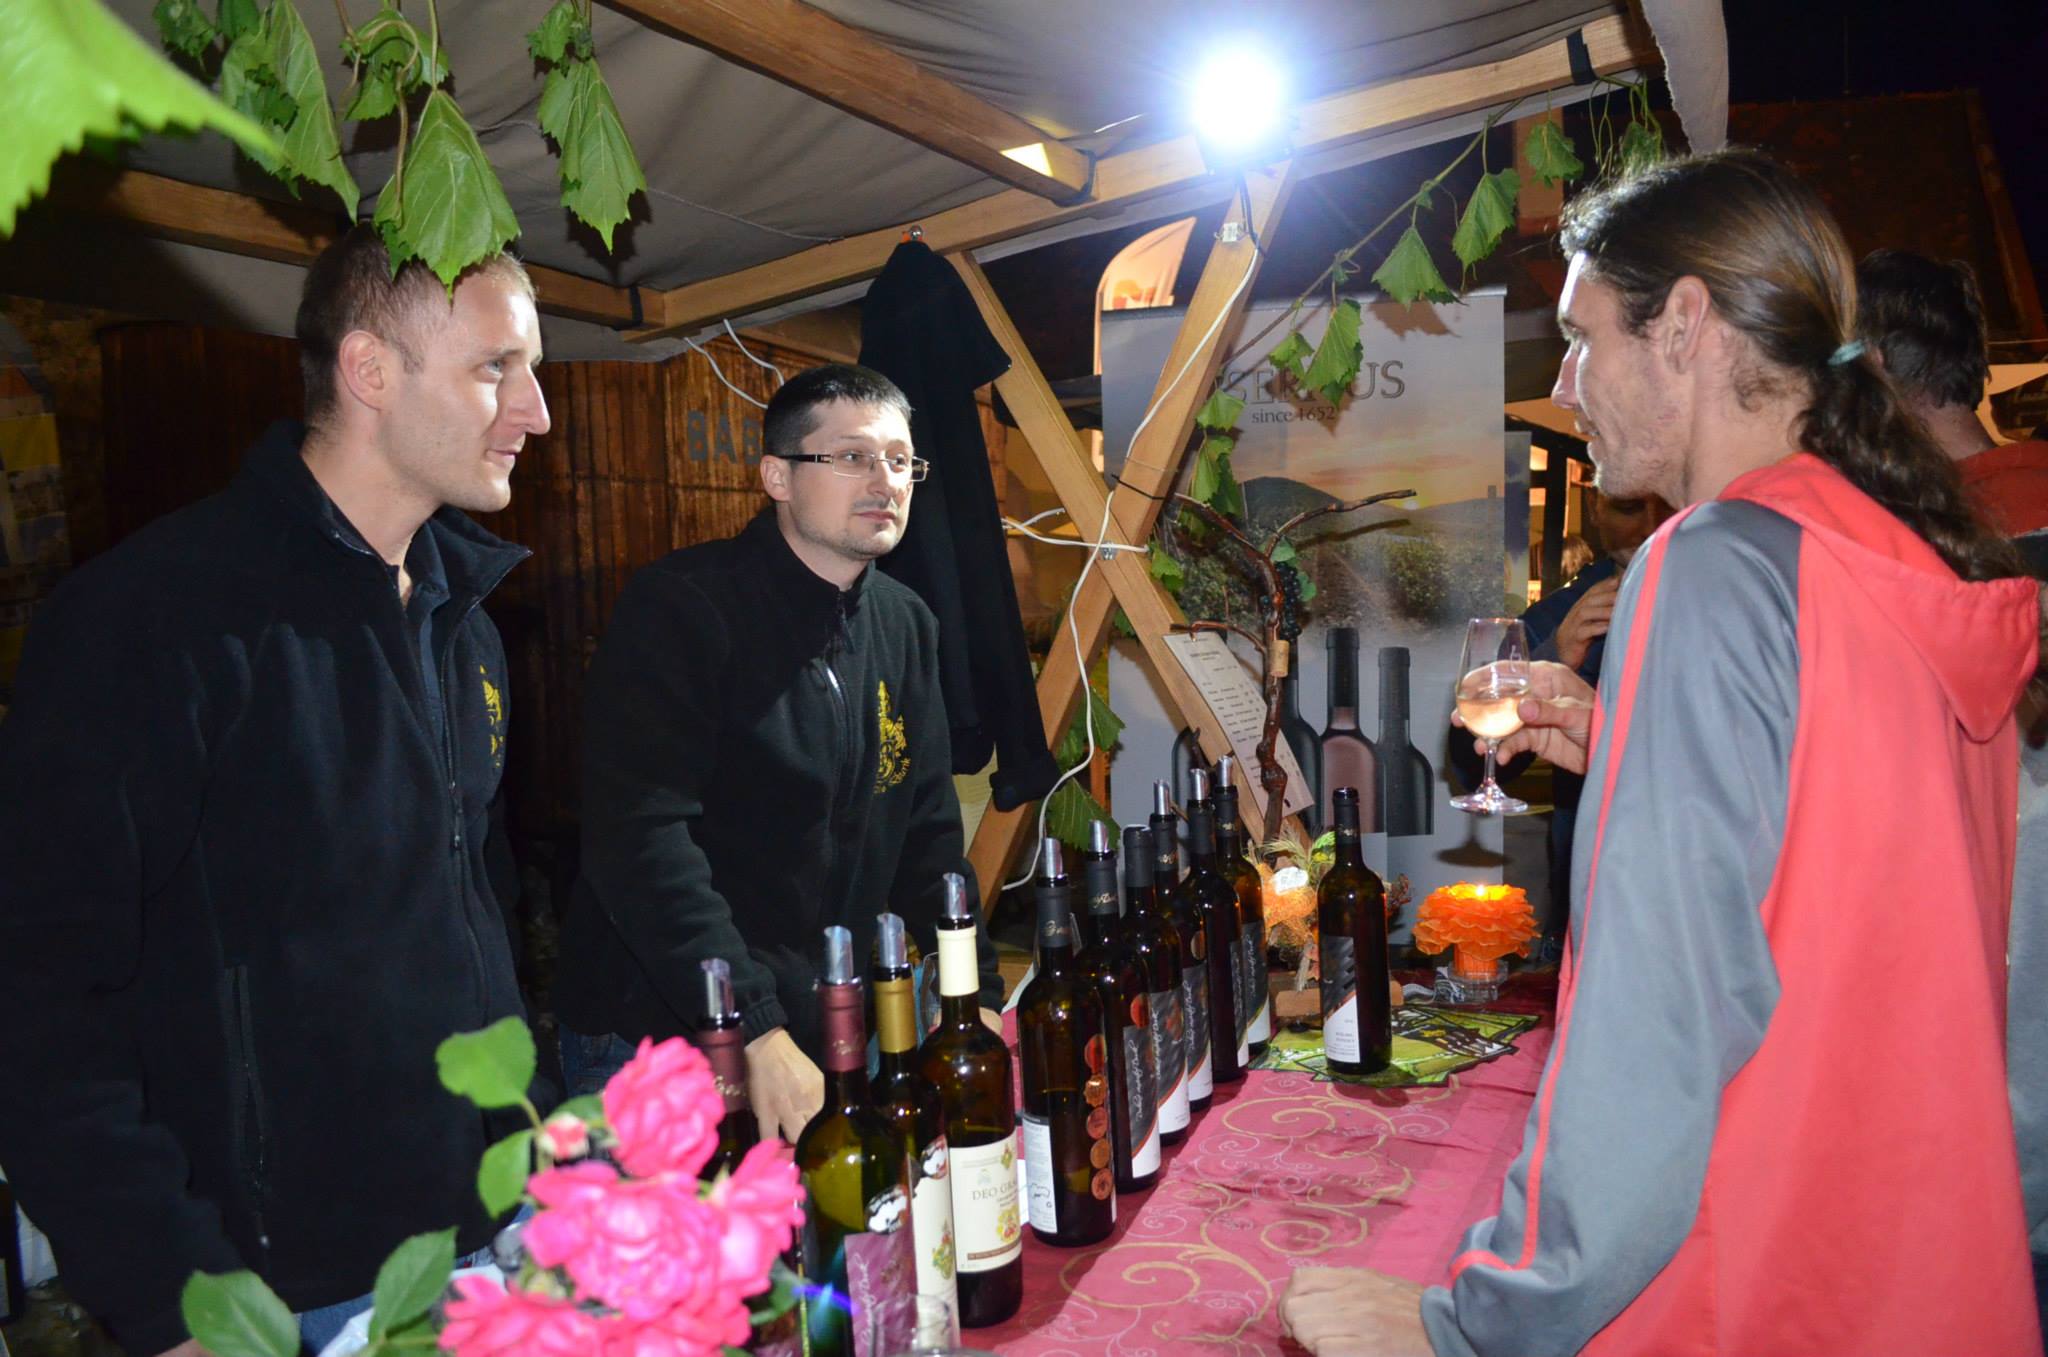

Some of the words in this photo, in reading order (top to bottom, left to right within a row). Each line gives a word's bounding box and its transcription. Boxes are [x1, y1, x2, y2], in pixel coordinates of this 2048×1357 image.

[1251, 409, 1294, 424] since
[1298, 406, 1336, 422] 1652
[972, 1186, 998, 1201] DEO
